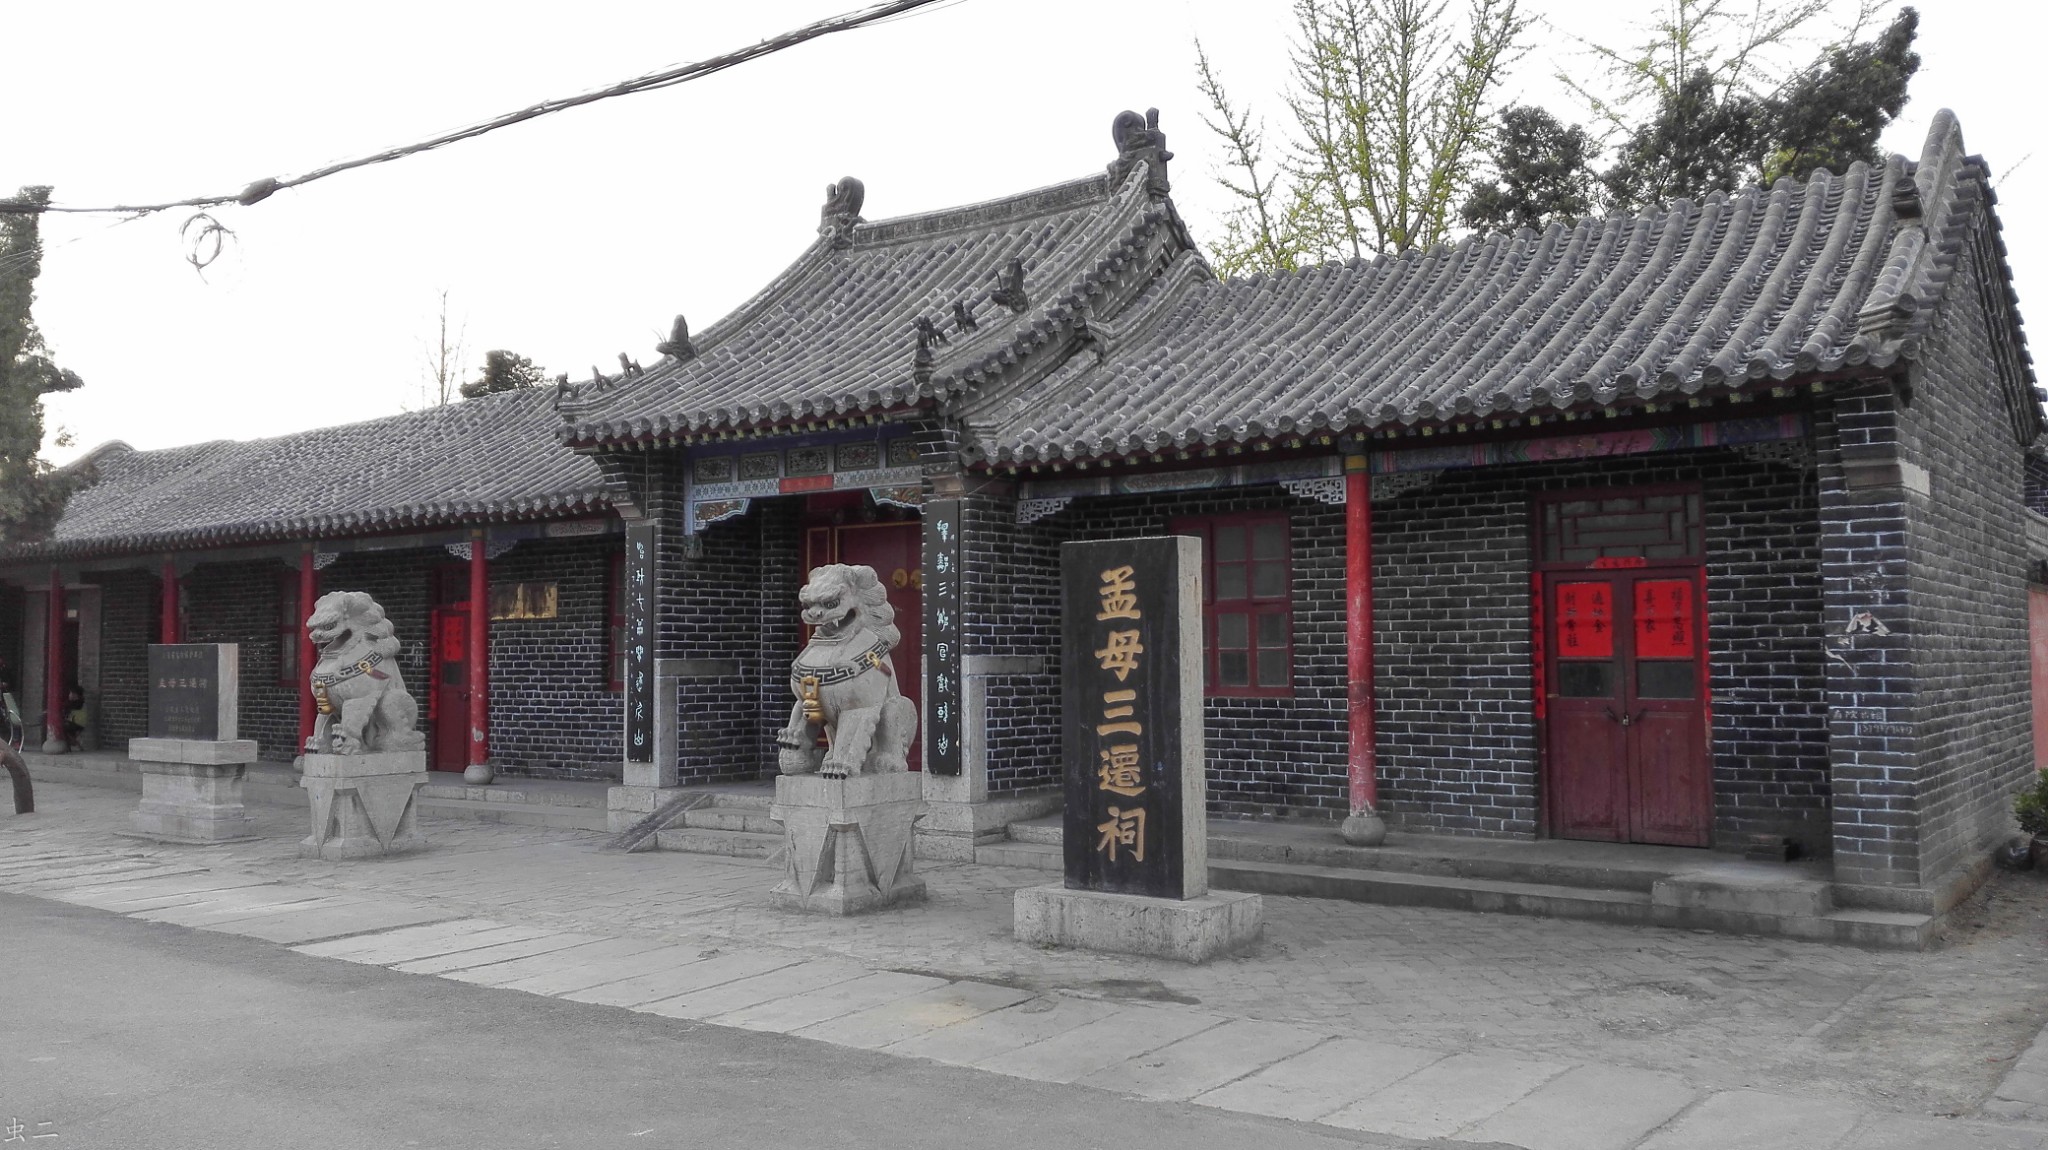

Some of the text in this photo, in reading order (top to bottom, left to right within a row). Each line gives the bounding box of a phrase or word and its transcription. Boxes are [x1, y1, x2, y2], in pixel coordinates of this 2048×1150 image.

[1094, 564, 1146, 862] 孟母三遷祠
